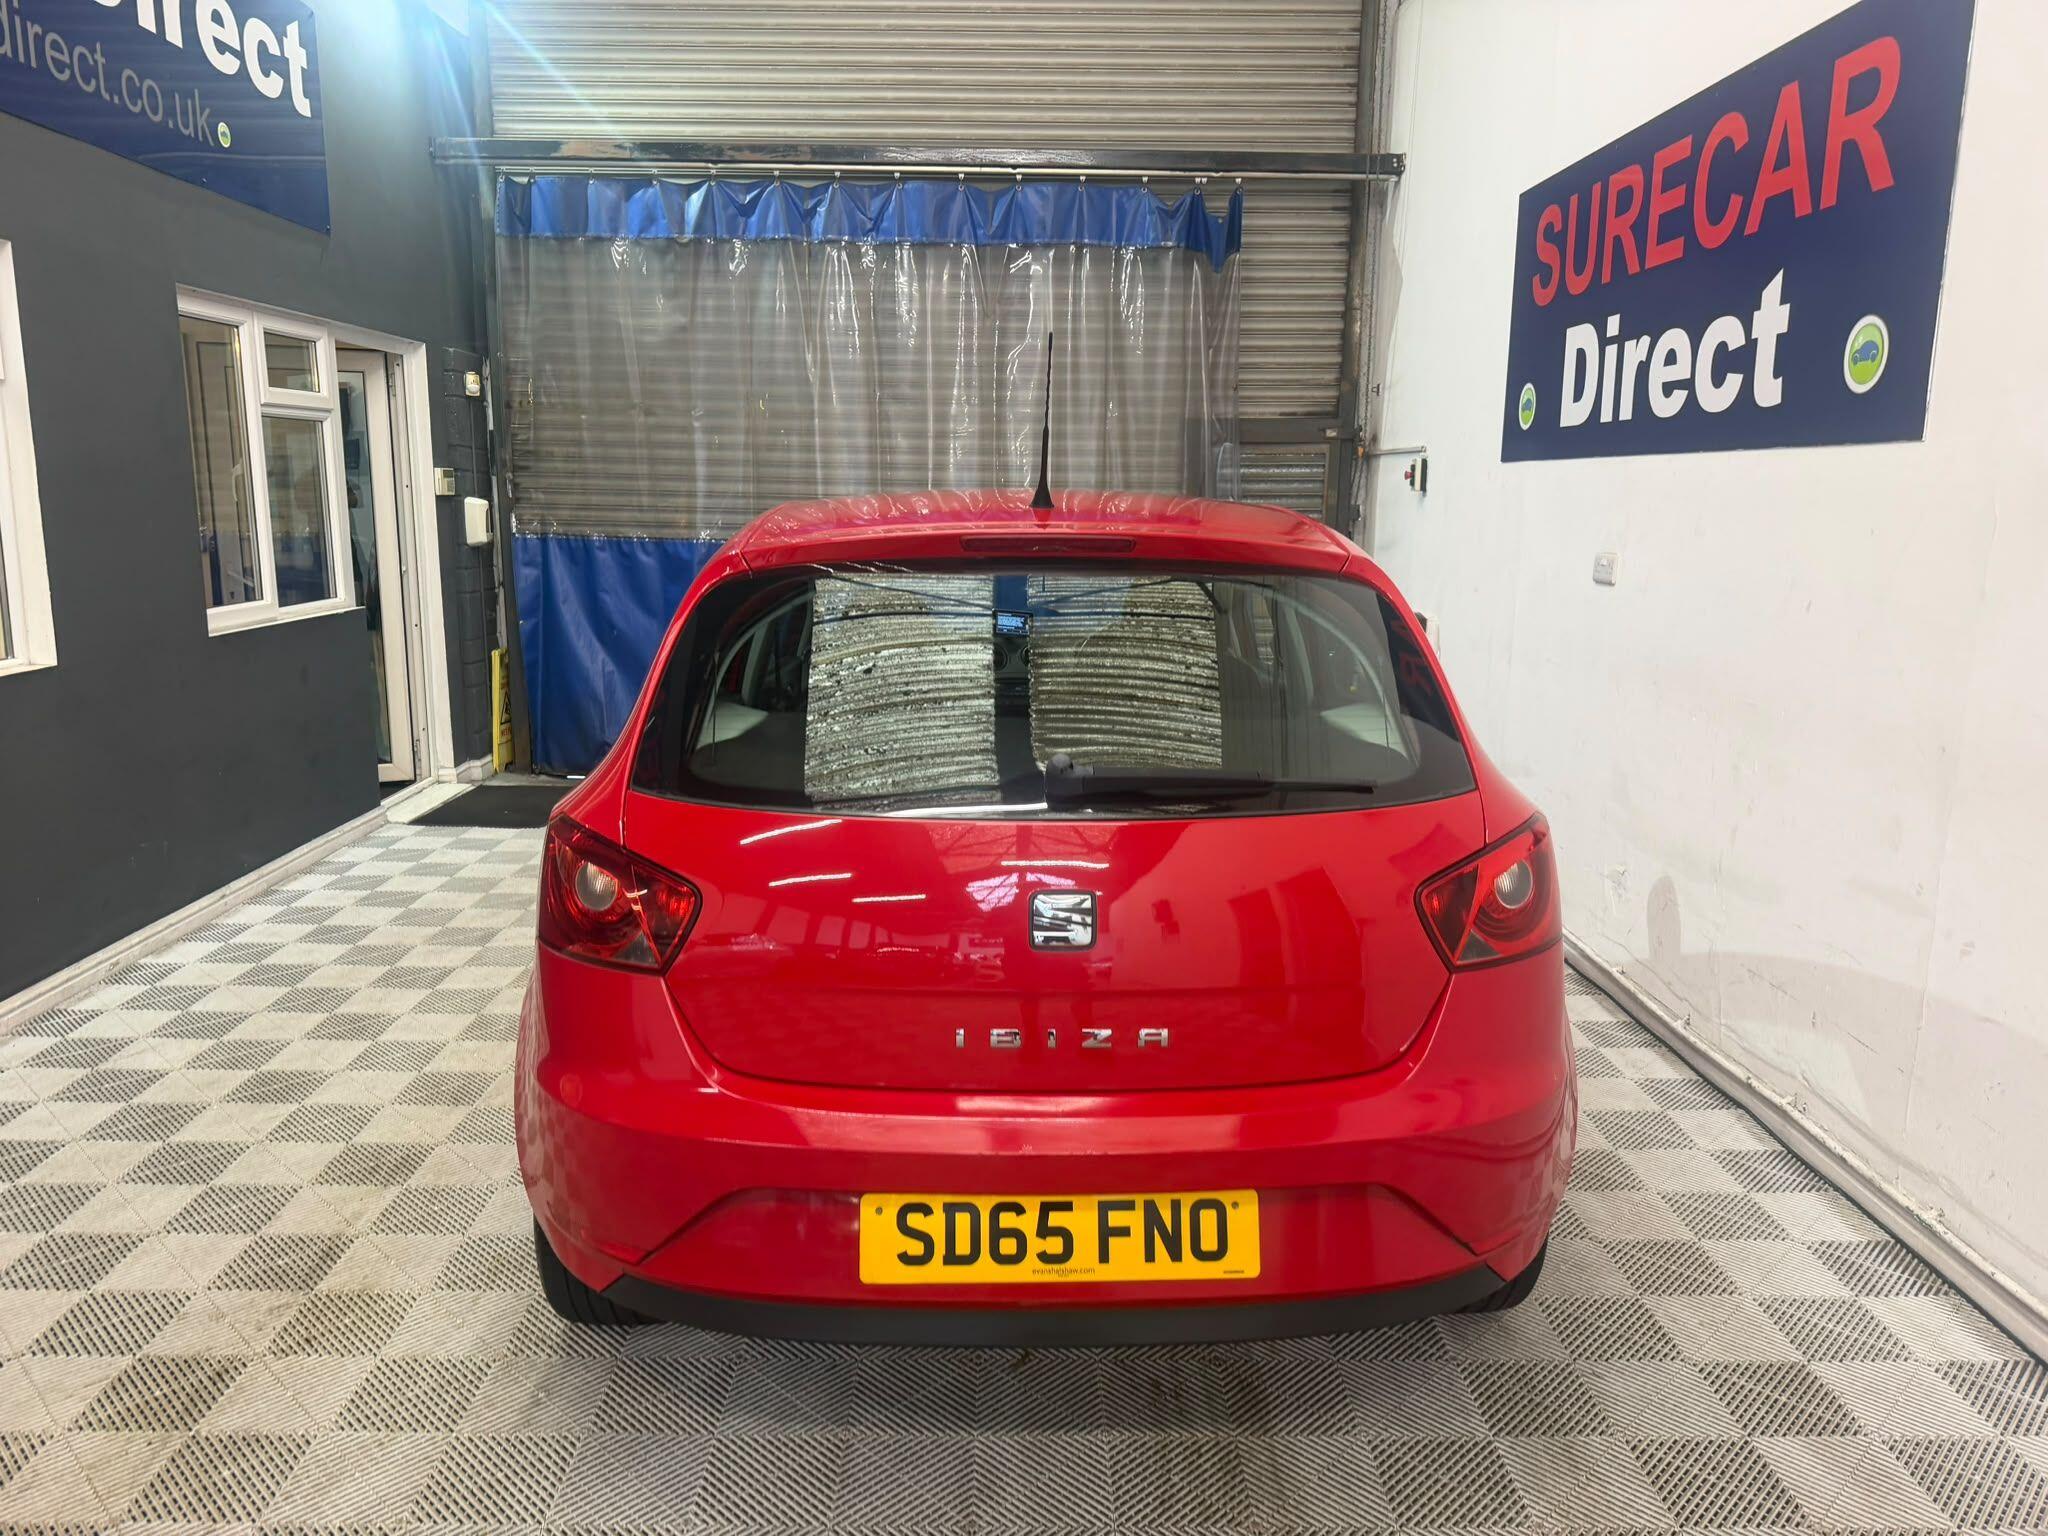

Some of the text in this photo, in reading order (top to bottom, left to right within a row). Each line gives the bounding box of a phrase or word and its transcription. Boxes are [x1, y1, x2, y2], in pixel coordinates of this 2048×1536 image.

[93, 0, 311, 118] ect
[1532, 36, 1900, 306] SURECAR
[1560, 268, 1790, 427] Direct
[956, 1028, 1169, 1048] IBIZA
[896, 1198, 1229, 1266] SD65 FNO
